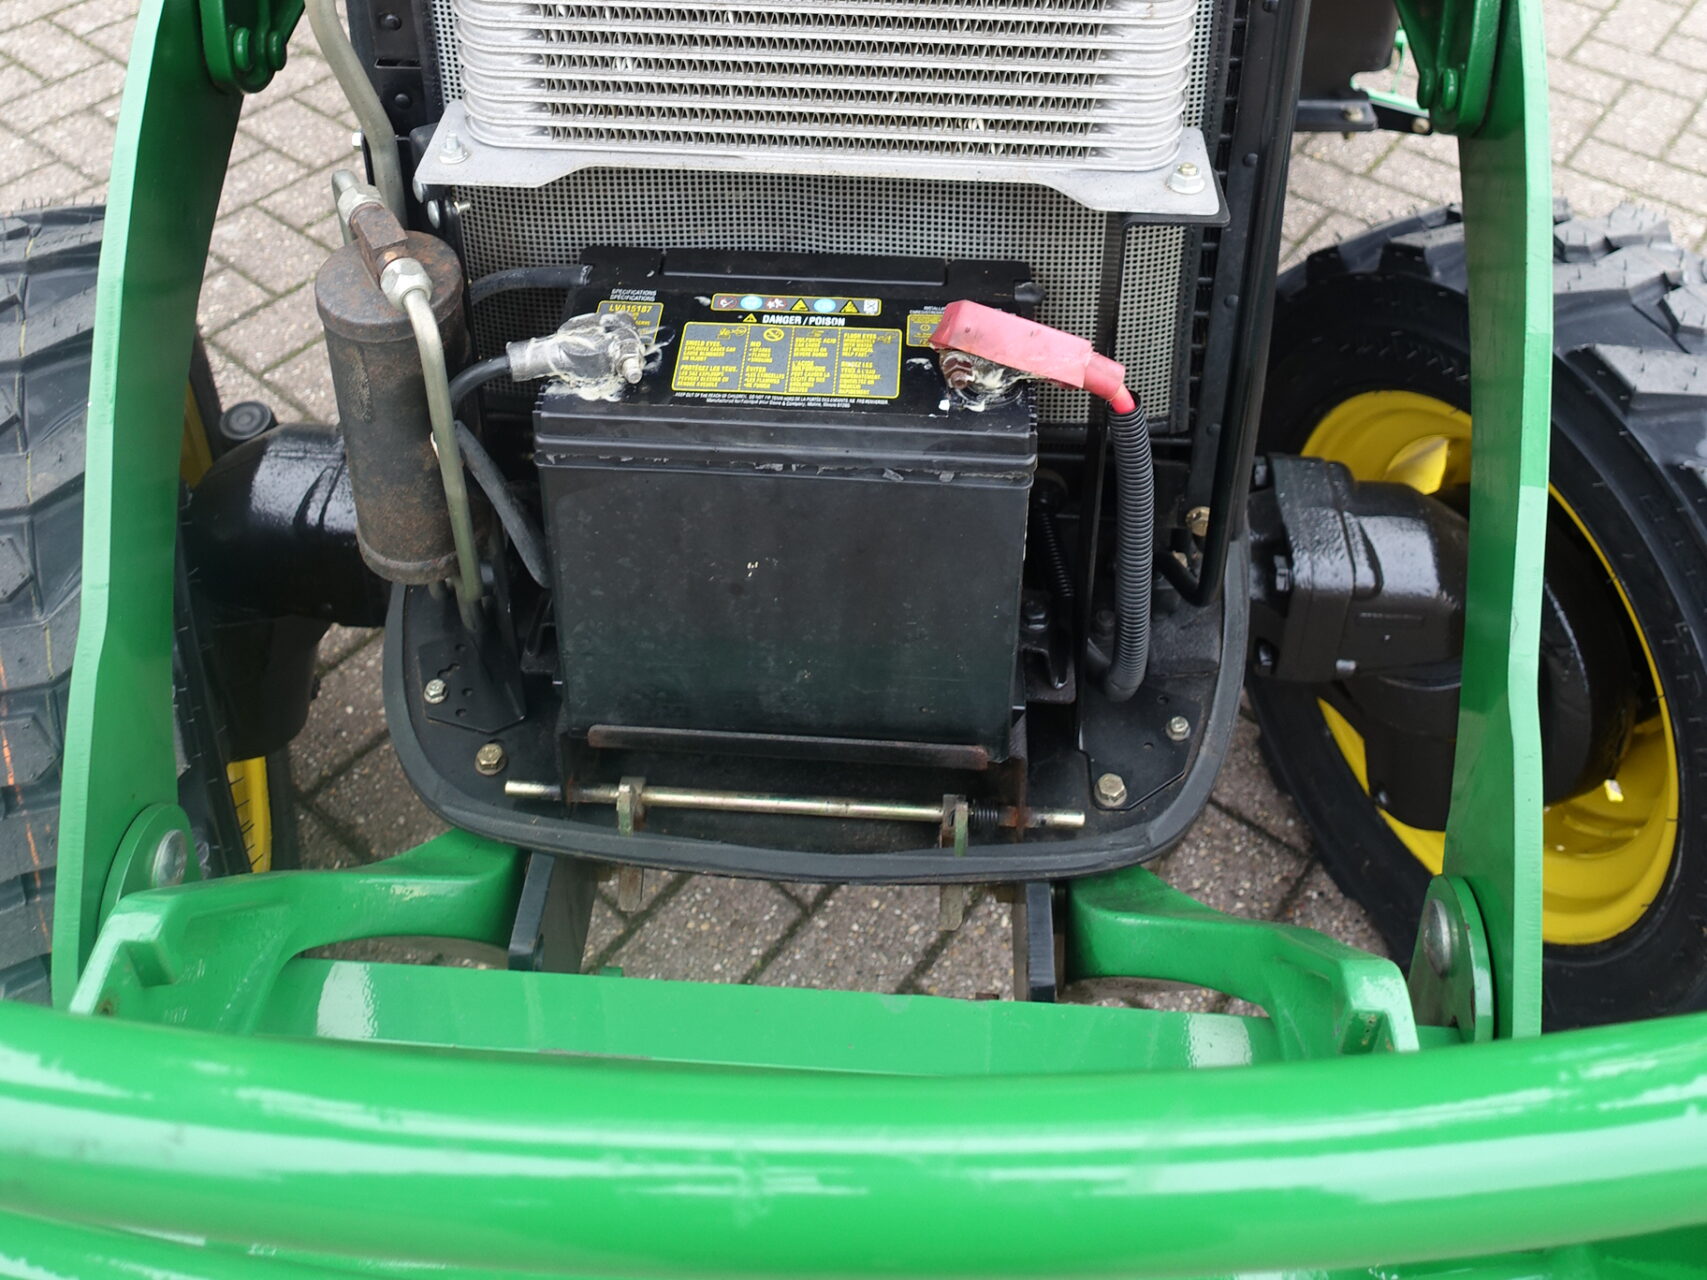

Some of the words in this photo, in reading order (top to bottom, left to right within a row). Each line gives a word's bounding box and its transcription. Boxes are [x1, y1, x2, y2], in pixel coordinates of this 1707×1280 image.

[611, 288, 657, 296] SPECIFICATIONS
[609, 294, 655, 302] SPECIFICATIONS
[761, 314, 802, 325] DANGER
[808, 316, 846, 327] POISON
